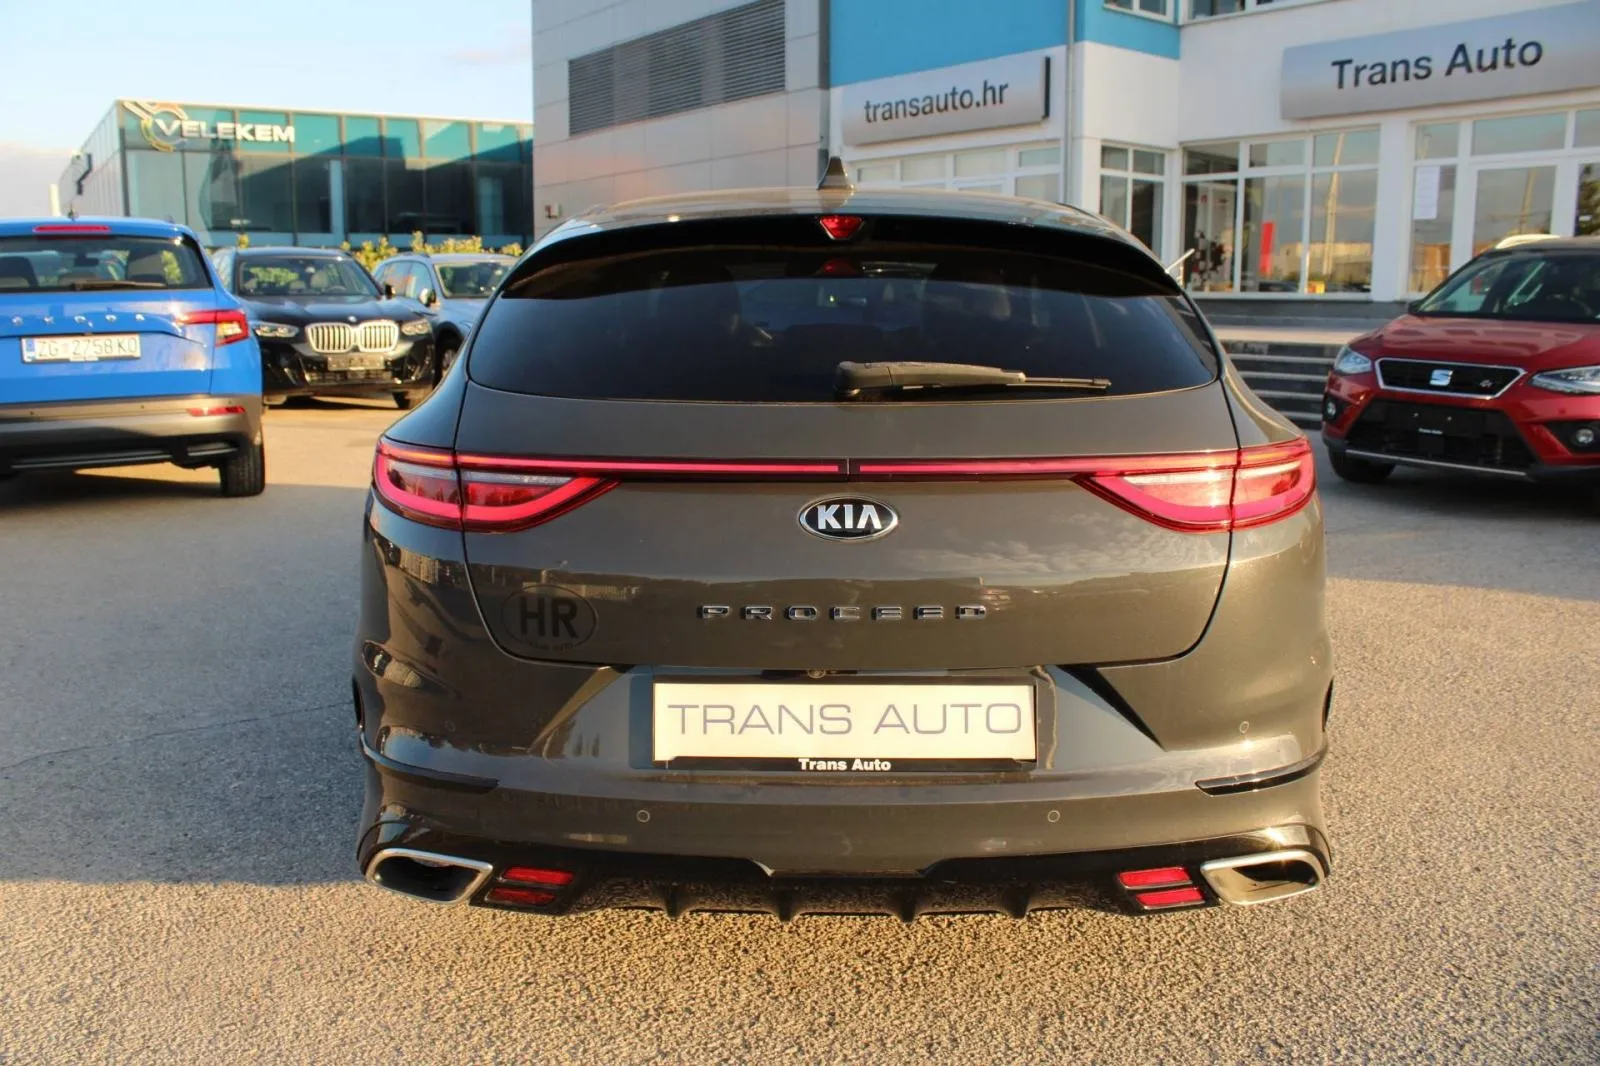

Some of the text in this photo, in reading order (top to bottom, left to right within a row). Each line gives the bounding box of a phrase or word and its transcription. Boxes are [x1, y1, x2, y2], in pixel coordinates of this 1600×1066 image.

[1331, 37, 1543, 90] Trans Auto
[863, 79, 1009, 124] transauto.hr
[154, 117, 296, 144] VELEKEM
[817, 503, 883, 530] KIA
[519, 596, 579, 639] HR
[699, 604, 987, 621] PROCEED
[667, 703, 1022, 735] TRANS AUTO
[798, 757, 892, 772] Trans Auto
